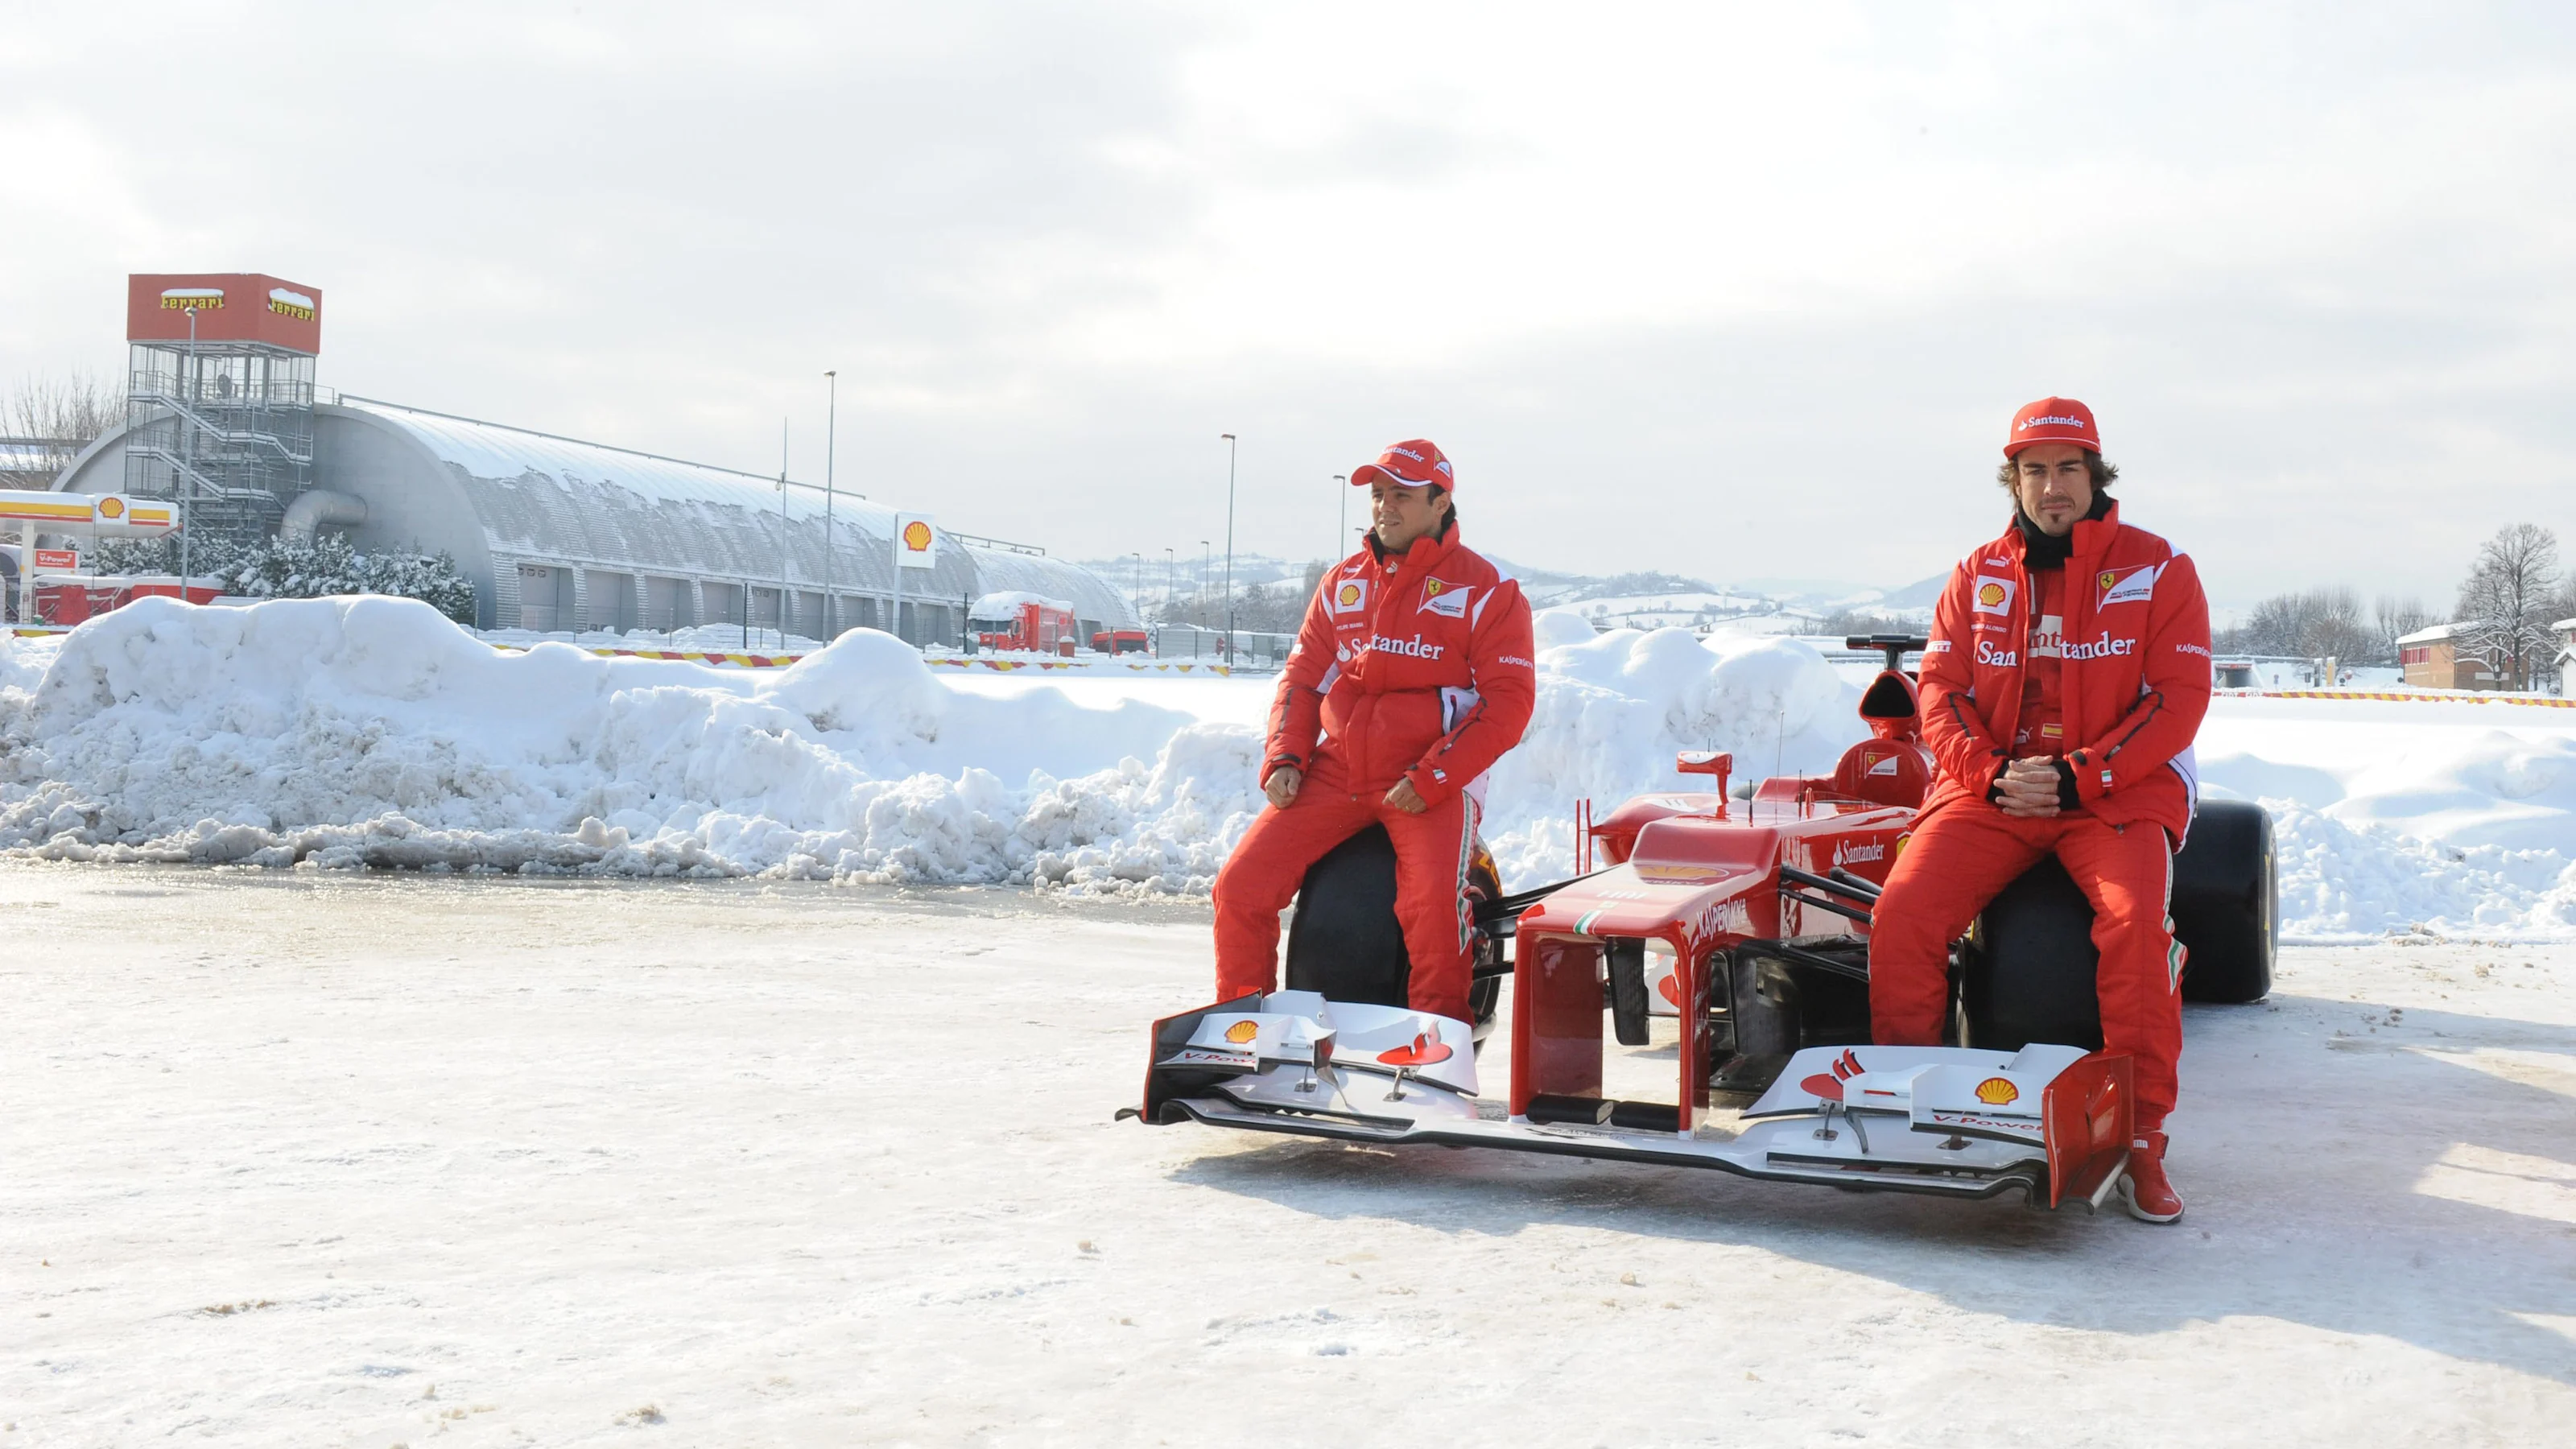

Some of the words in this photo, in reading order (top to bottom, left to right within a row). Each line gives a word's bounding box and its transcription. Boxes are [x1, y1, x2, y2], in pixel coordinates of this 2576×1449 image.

[161, 295, 224, 309] Ferrari
[2029, 415, 2084, 428] Santander
[1985, 624, 2008, 634] ALONSO
[1351, 633, 1443, 660] Satander
[1843, 834, 1885, 865] Santander
[1185, 1053, 1256, 1064] V-Pow
